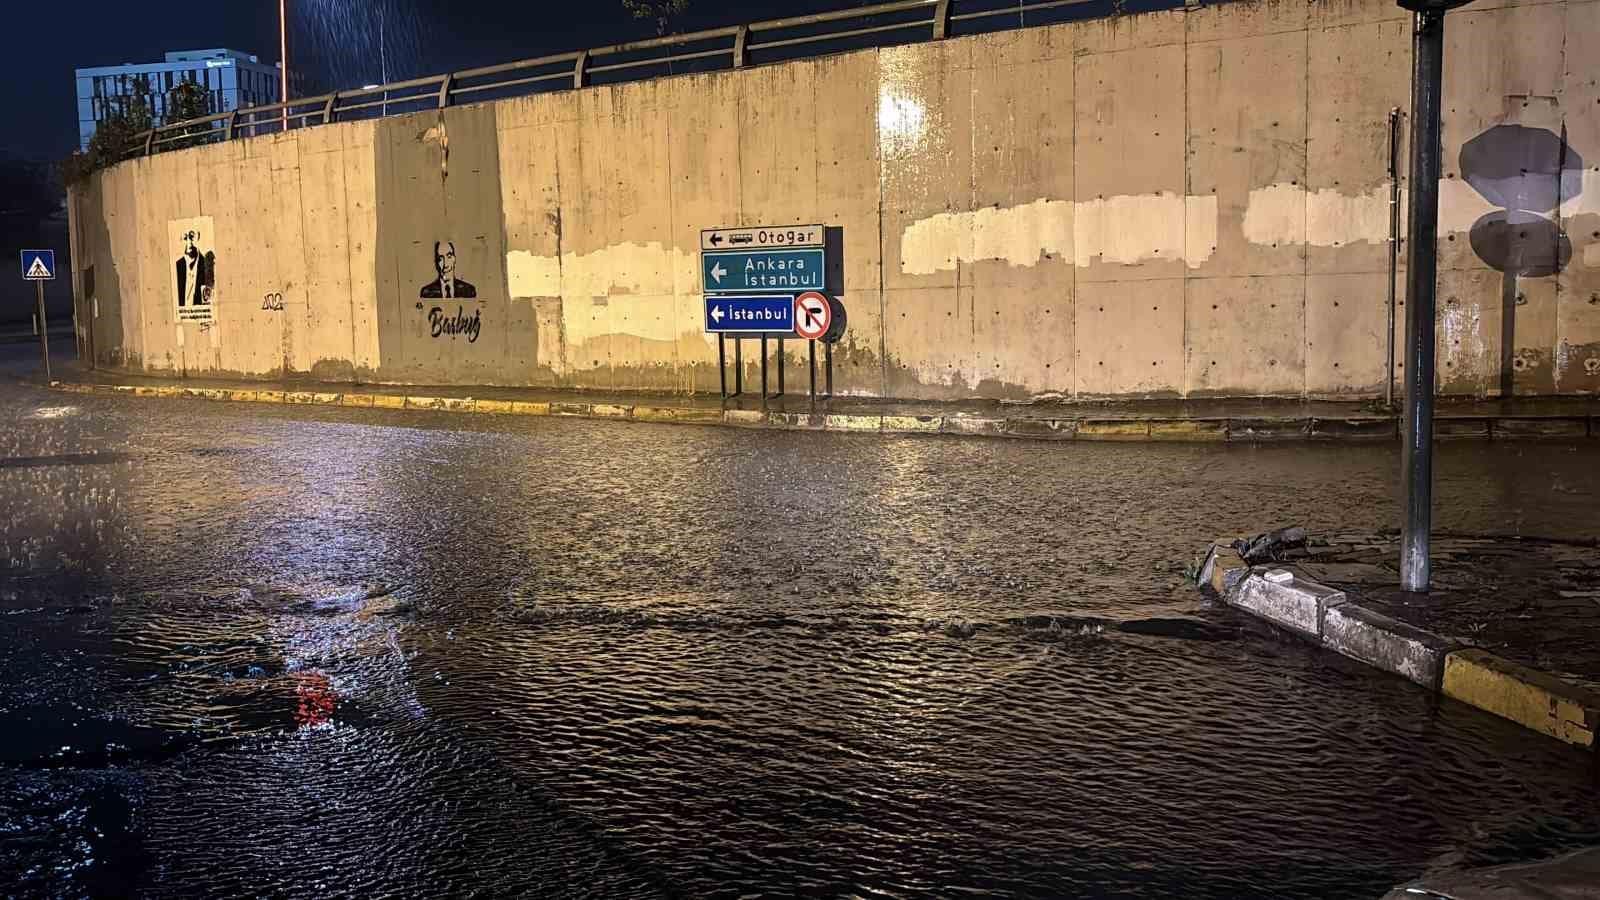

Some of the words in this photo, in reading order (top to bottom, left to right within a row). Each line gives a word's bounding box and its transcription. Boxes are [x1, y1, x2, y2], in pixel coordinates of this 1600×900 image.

[758, 230, 814, 245] Otogar
[744, 256, 804, 271] Ankara
[729, 304, 787, 320] İstanbul
